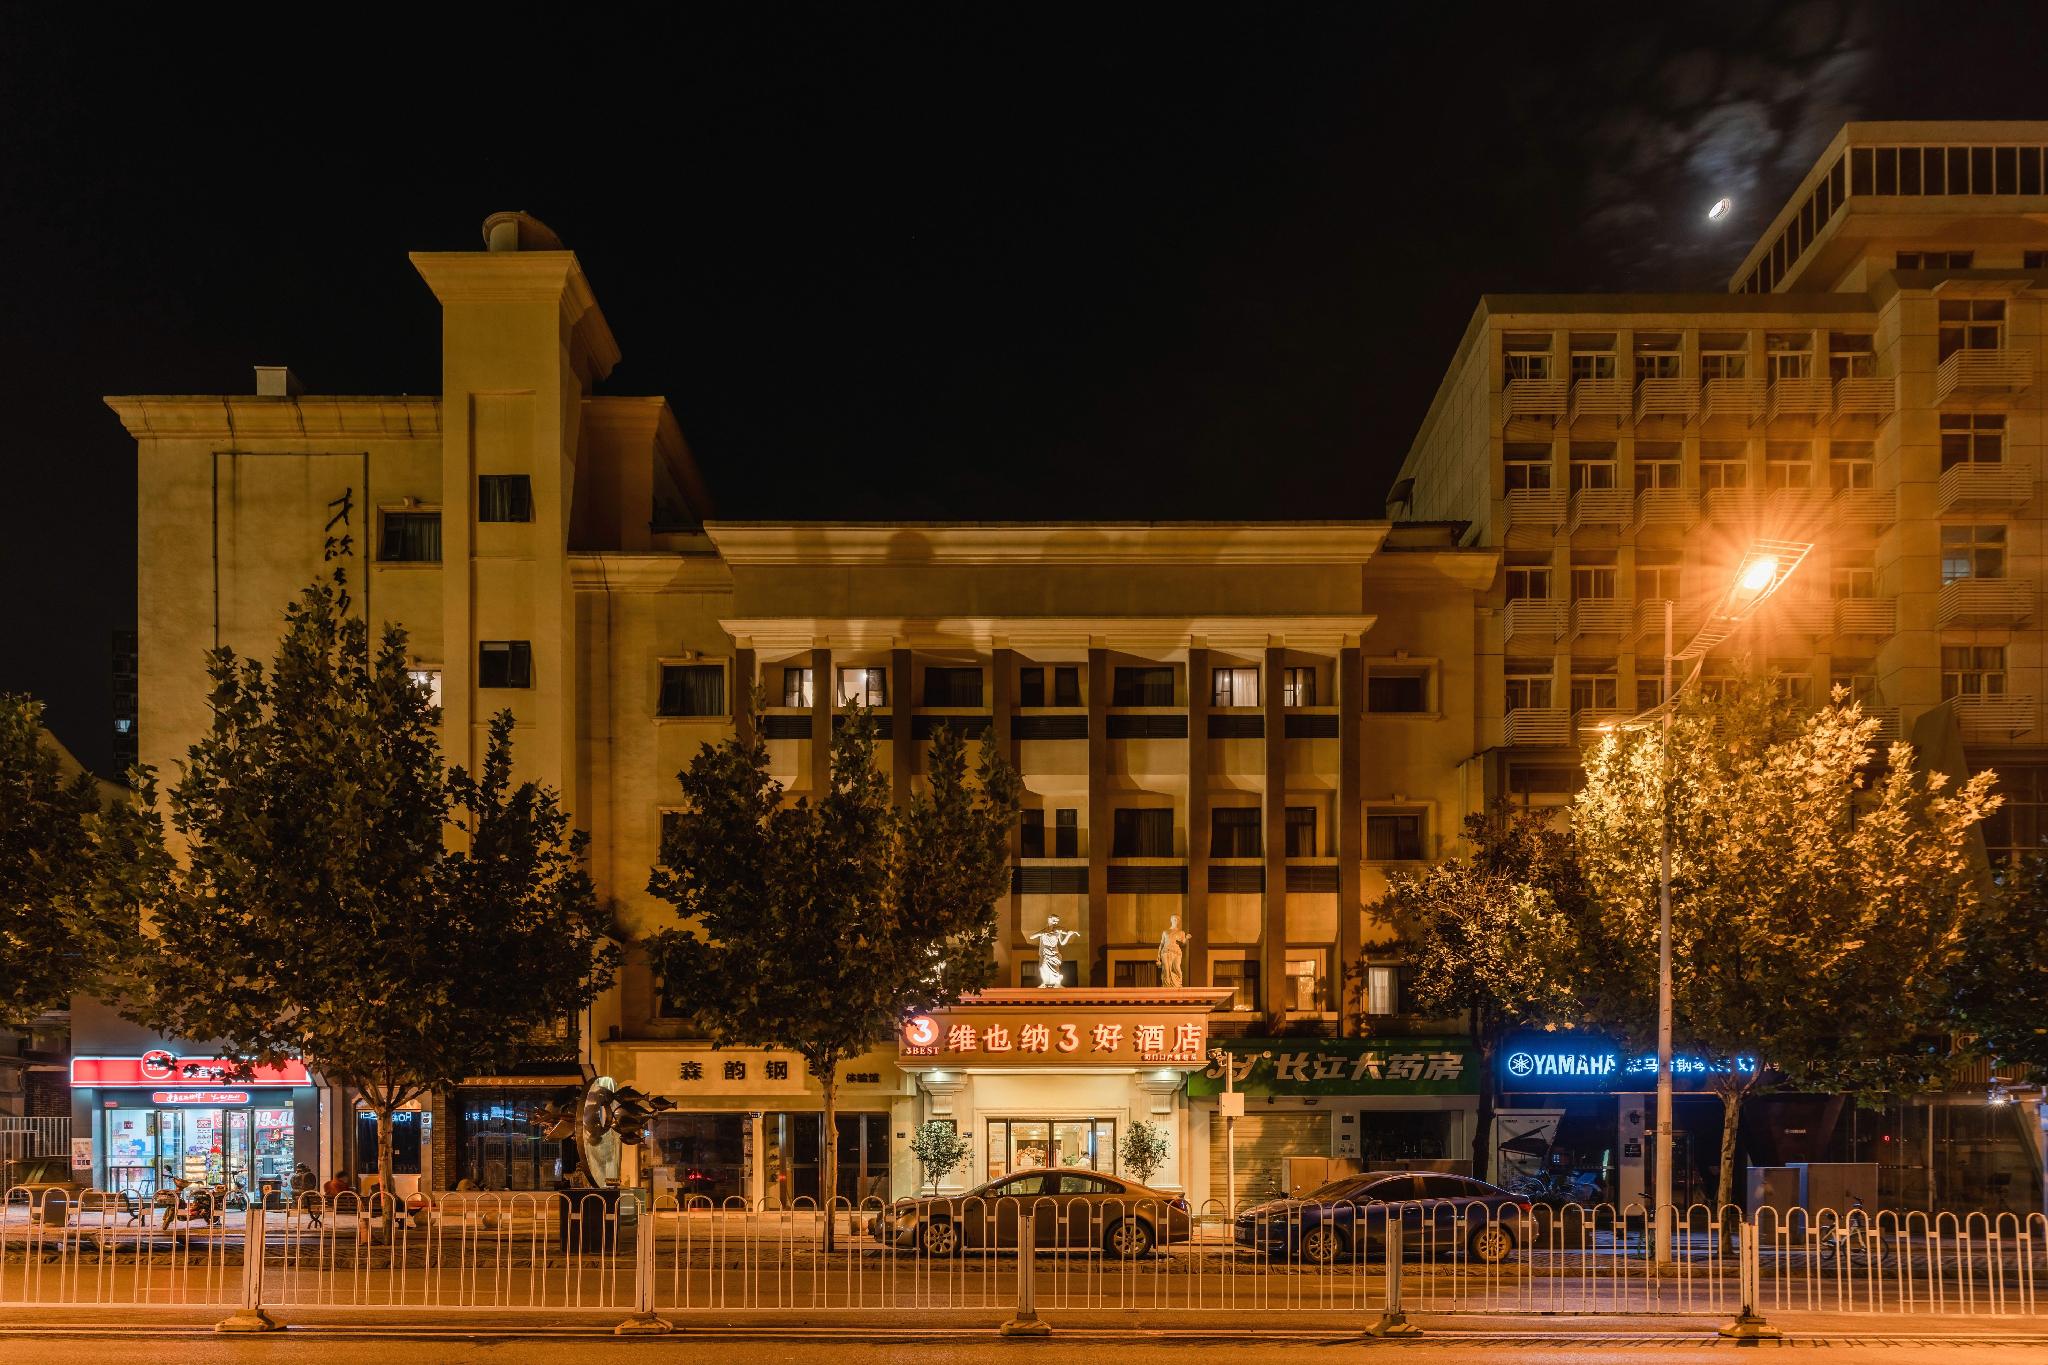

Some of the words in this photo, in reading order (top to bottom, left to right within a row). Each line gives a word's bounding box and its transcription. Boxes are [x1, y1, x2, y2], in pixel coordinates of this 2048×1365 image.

[948, 1023, 1202, 1052] 维也纳3好酒店
[906, 1046, 940, 1055] 3BEST
[1274, 1051, 1464, 1082] 长江大药房
[1534, 1055, 1616, 1075] YAMAHA
